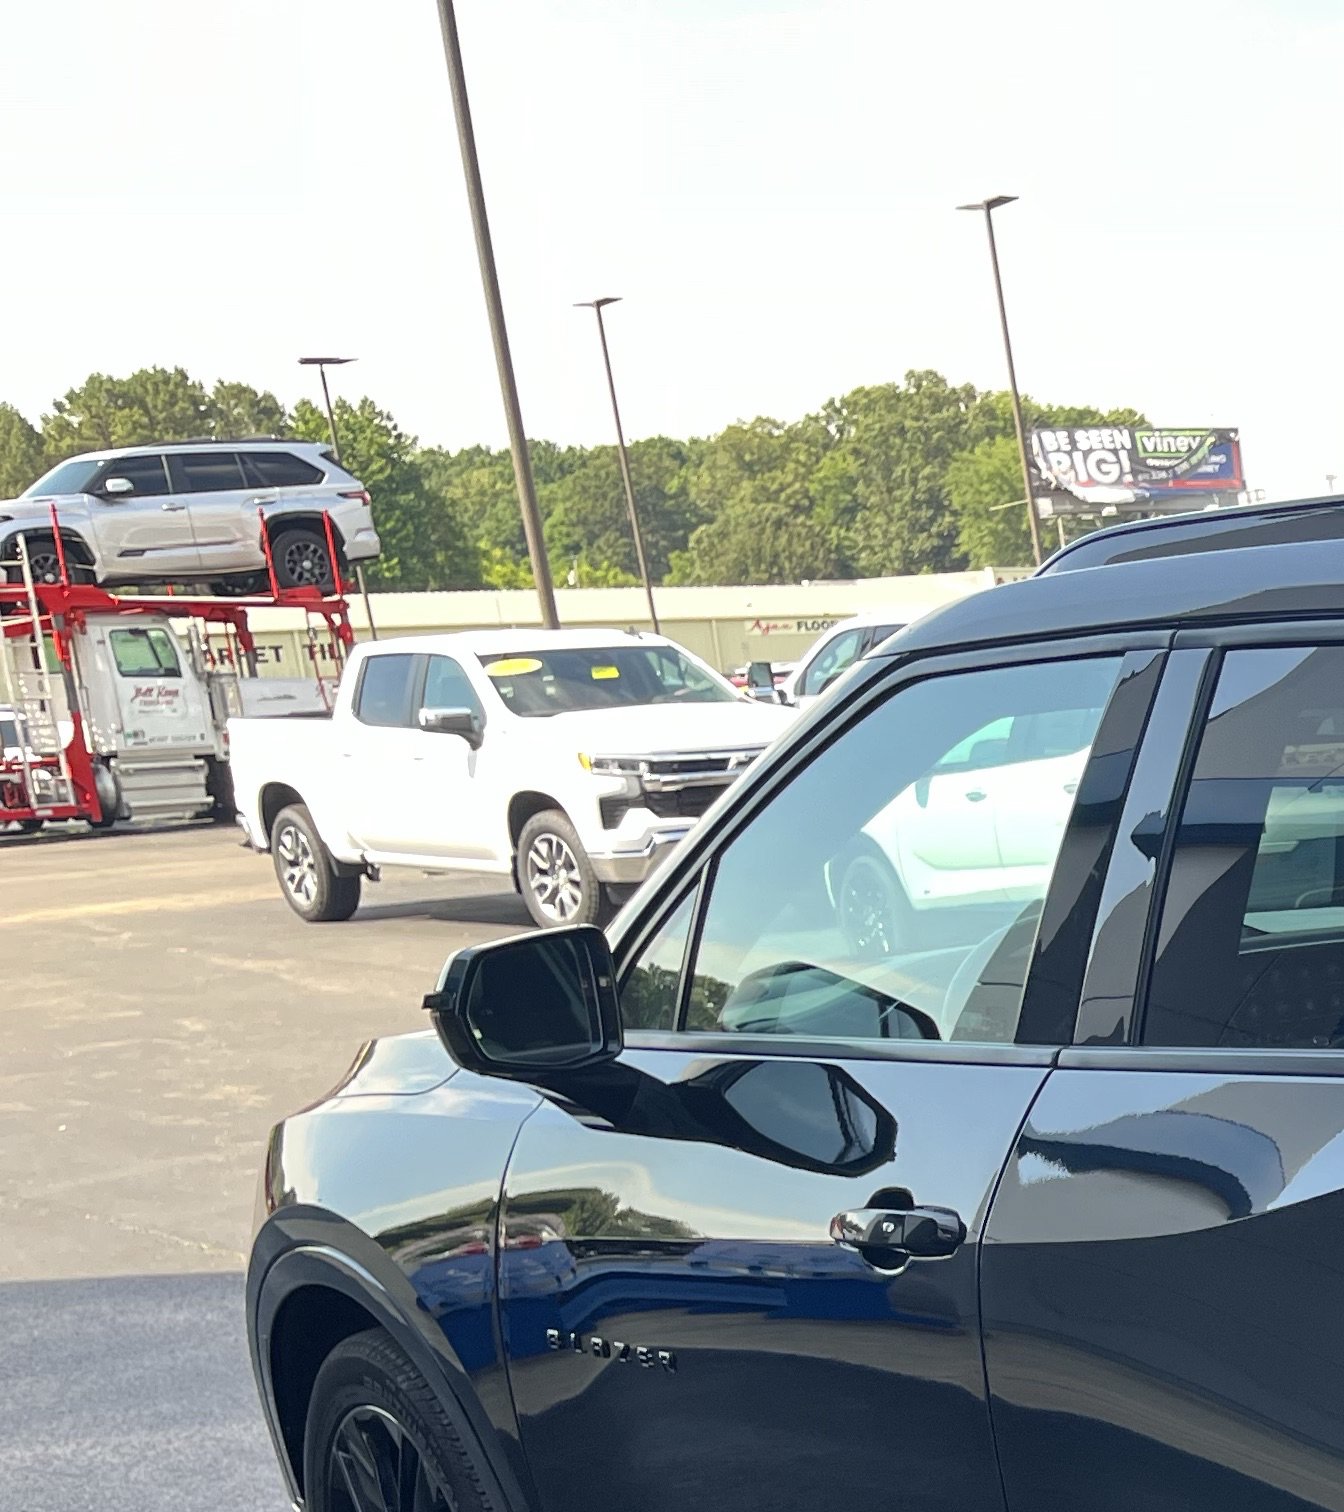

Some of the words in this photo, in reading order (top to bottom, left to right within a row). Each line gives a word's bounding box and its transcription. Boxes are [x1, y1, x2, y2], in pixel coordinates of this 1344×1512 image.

[1040, 430, 1072, 451] BE
[1074, 428, 1133, 451] SEEN
[546, 1327, 678, 1374] BLAZER
